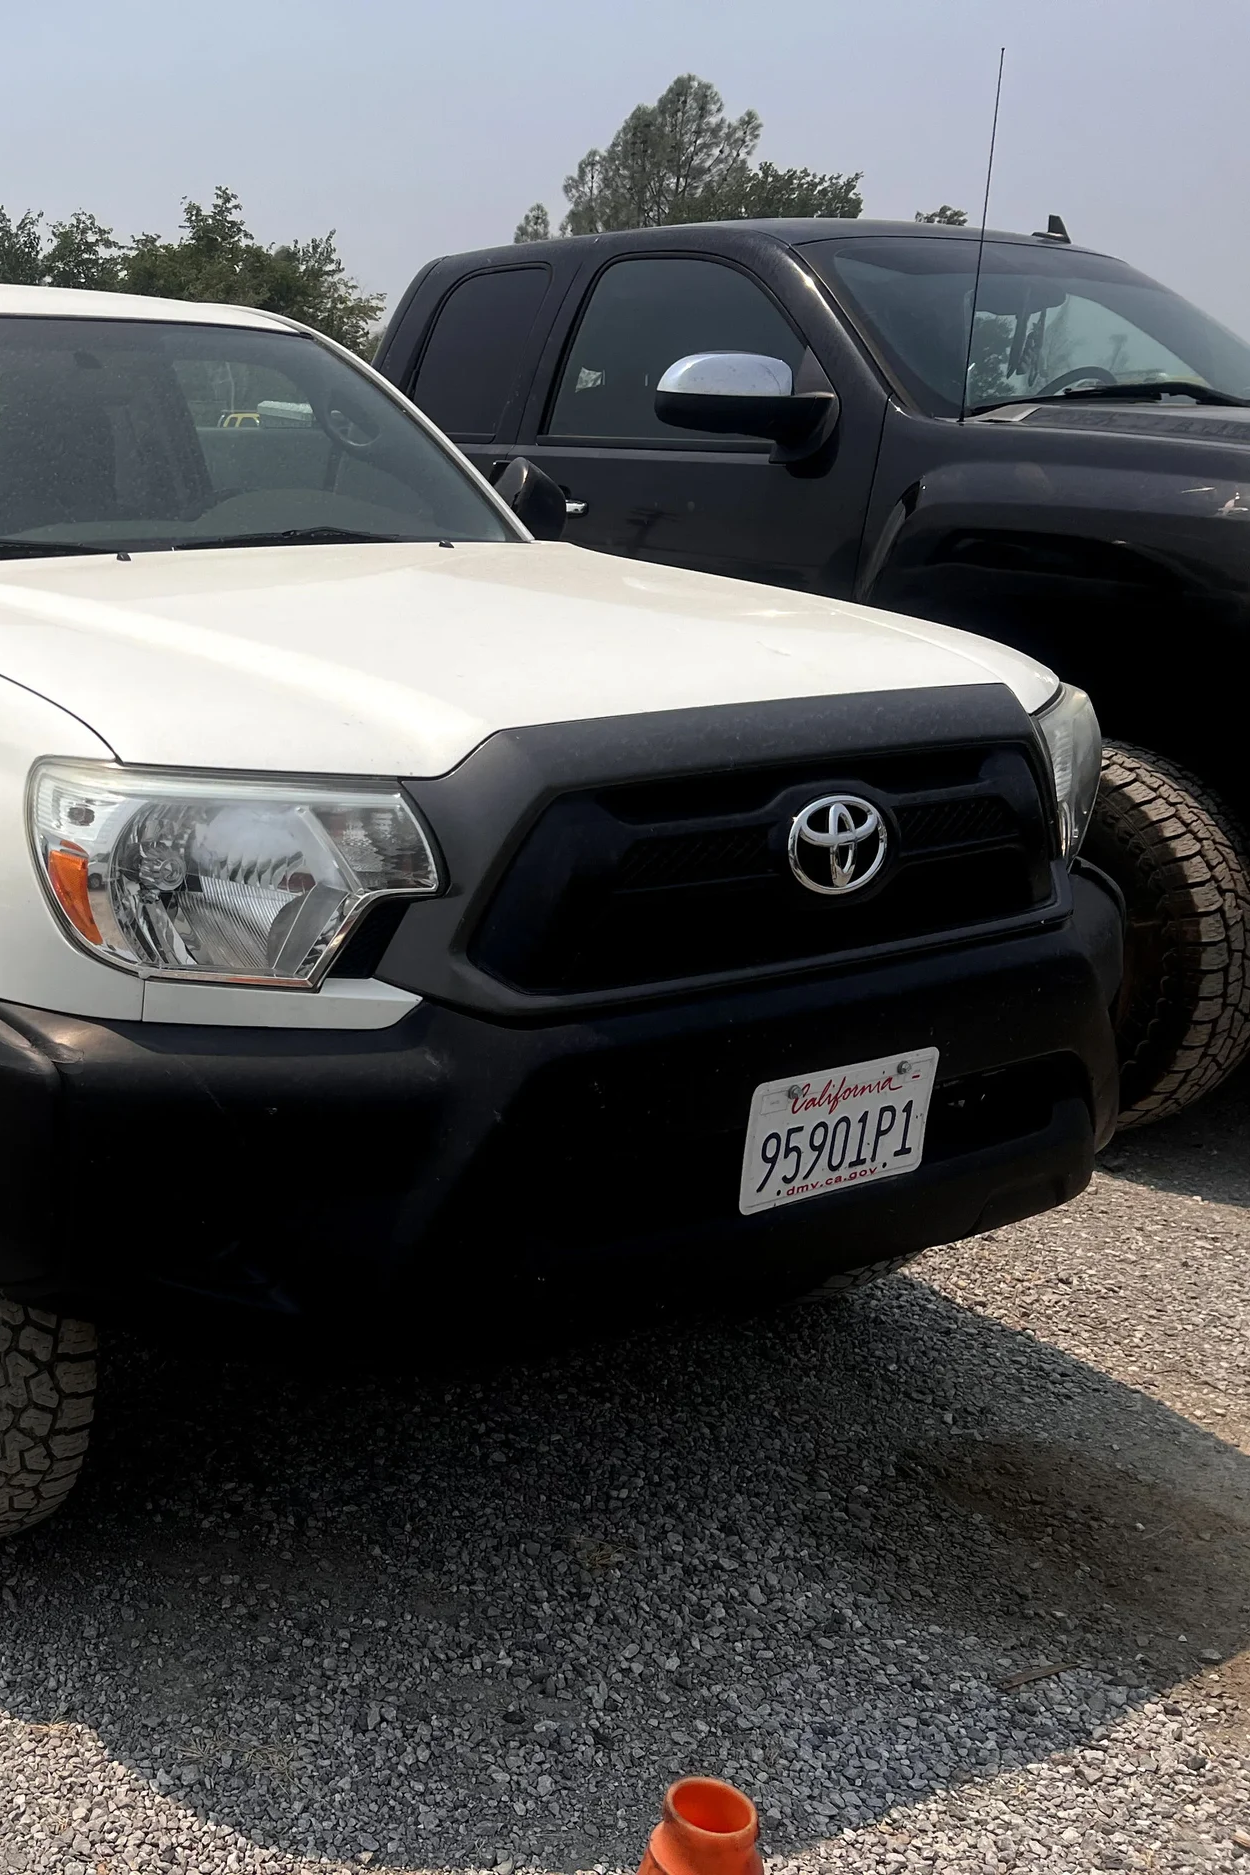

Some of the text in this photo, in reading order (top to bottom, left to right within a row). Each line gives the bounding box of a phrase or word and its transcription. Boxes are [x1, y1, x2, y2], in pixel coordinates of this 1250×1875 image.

[791, 1075, 903, 1115] California
[755, 1099, 914, 1194] 95901P1
[786, 1166, 878, 1197] dmv.ca.gov
